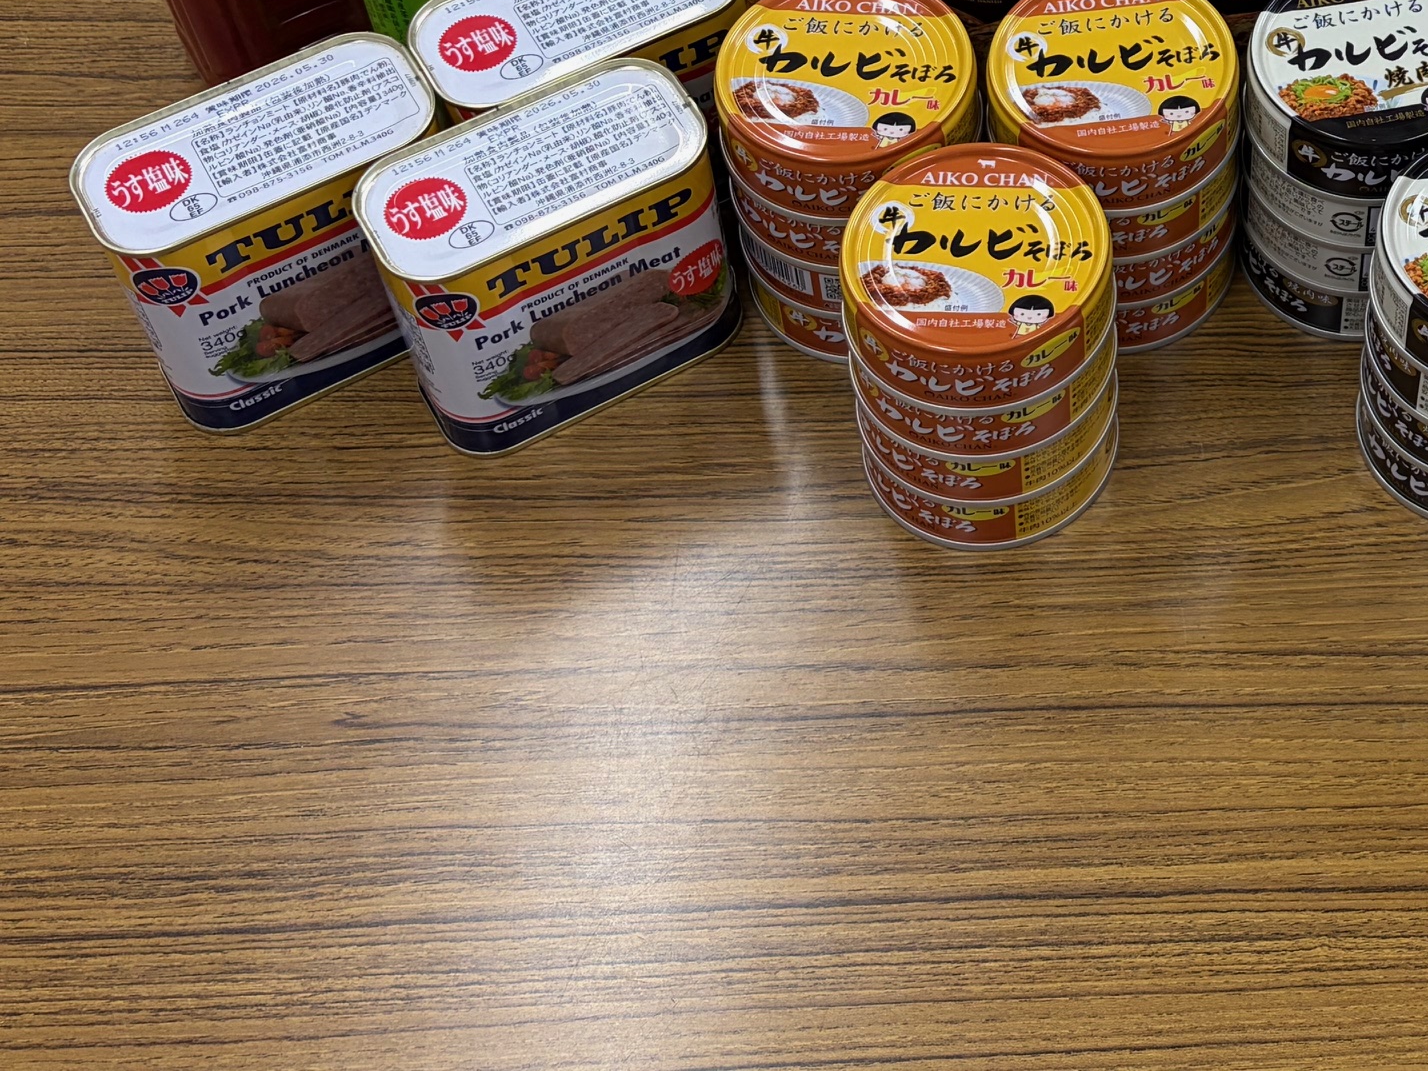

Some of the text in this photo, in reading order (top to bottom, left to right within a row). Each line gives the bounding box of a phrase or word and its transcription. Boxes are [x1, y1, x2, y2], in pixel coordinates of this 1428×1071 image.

[796, 0, 851, 12] AIKO
[1293, 0, 1423, 30] ご飯にかける
[783, 17, 924, 38] ご飯にかける
[1037, 7, 1174, 36] ご飯にかける
[444, 22, 513, 66] うす塩味
[754, 29, 779, 50] 牛
[1016, 36, 1039, 57] 牛
[1274, 32, 1296, 51] 牛
[759, 44, 957, 83] カルビそぼろ
[1027, 35, 1220, 78] カルビそぼろ
[1143, 74, 1216, 94] カレー味
[524, 80, 601, 119] 2026.05.30
[868, 88, 941, 110] カレー味
[173, 111, 199, 127] 264
[111, 157, 190, 208] うす塩味
[921, 172, 1050, 187] AIKO CHAN
[390, 184, 465, 235] うす塩味
[908, 192, 1056, 212] ご飯にかける
[879, 207, 905, 229] 牛
[487, 189, 692, 293] TULIP
[890, 223, 1093, 262] カルビそぼろ
[247, 232, 359, 287] PRODUCT OF DENMARK
[671, 242, 724, 294] うす塩味
[199, 250, 355, 327] Pork Luncheon
[521, 258, 629, 313] PRODUCT OF DENMARK
[1002, 269, 1078, 292] カレー味
[475, 246, 682, 351] Pork Luncheon Meat
[891, 349, 1014, 375] ご飯にかける
[1025, 333, 1078, 366] カレー味
[885, 361, 1054, 397] カルビそぼろ
[229, 383, 283, 412] Classic
[1005, 392, 1062, 423] カレー味
[494, 407, 544, 434] Classic
[876, 397, 1036, 443] カルビそぼろ
[951, 461, 1012, 472] カレー味
[947, 506, 1006, 516] カレー味
